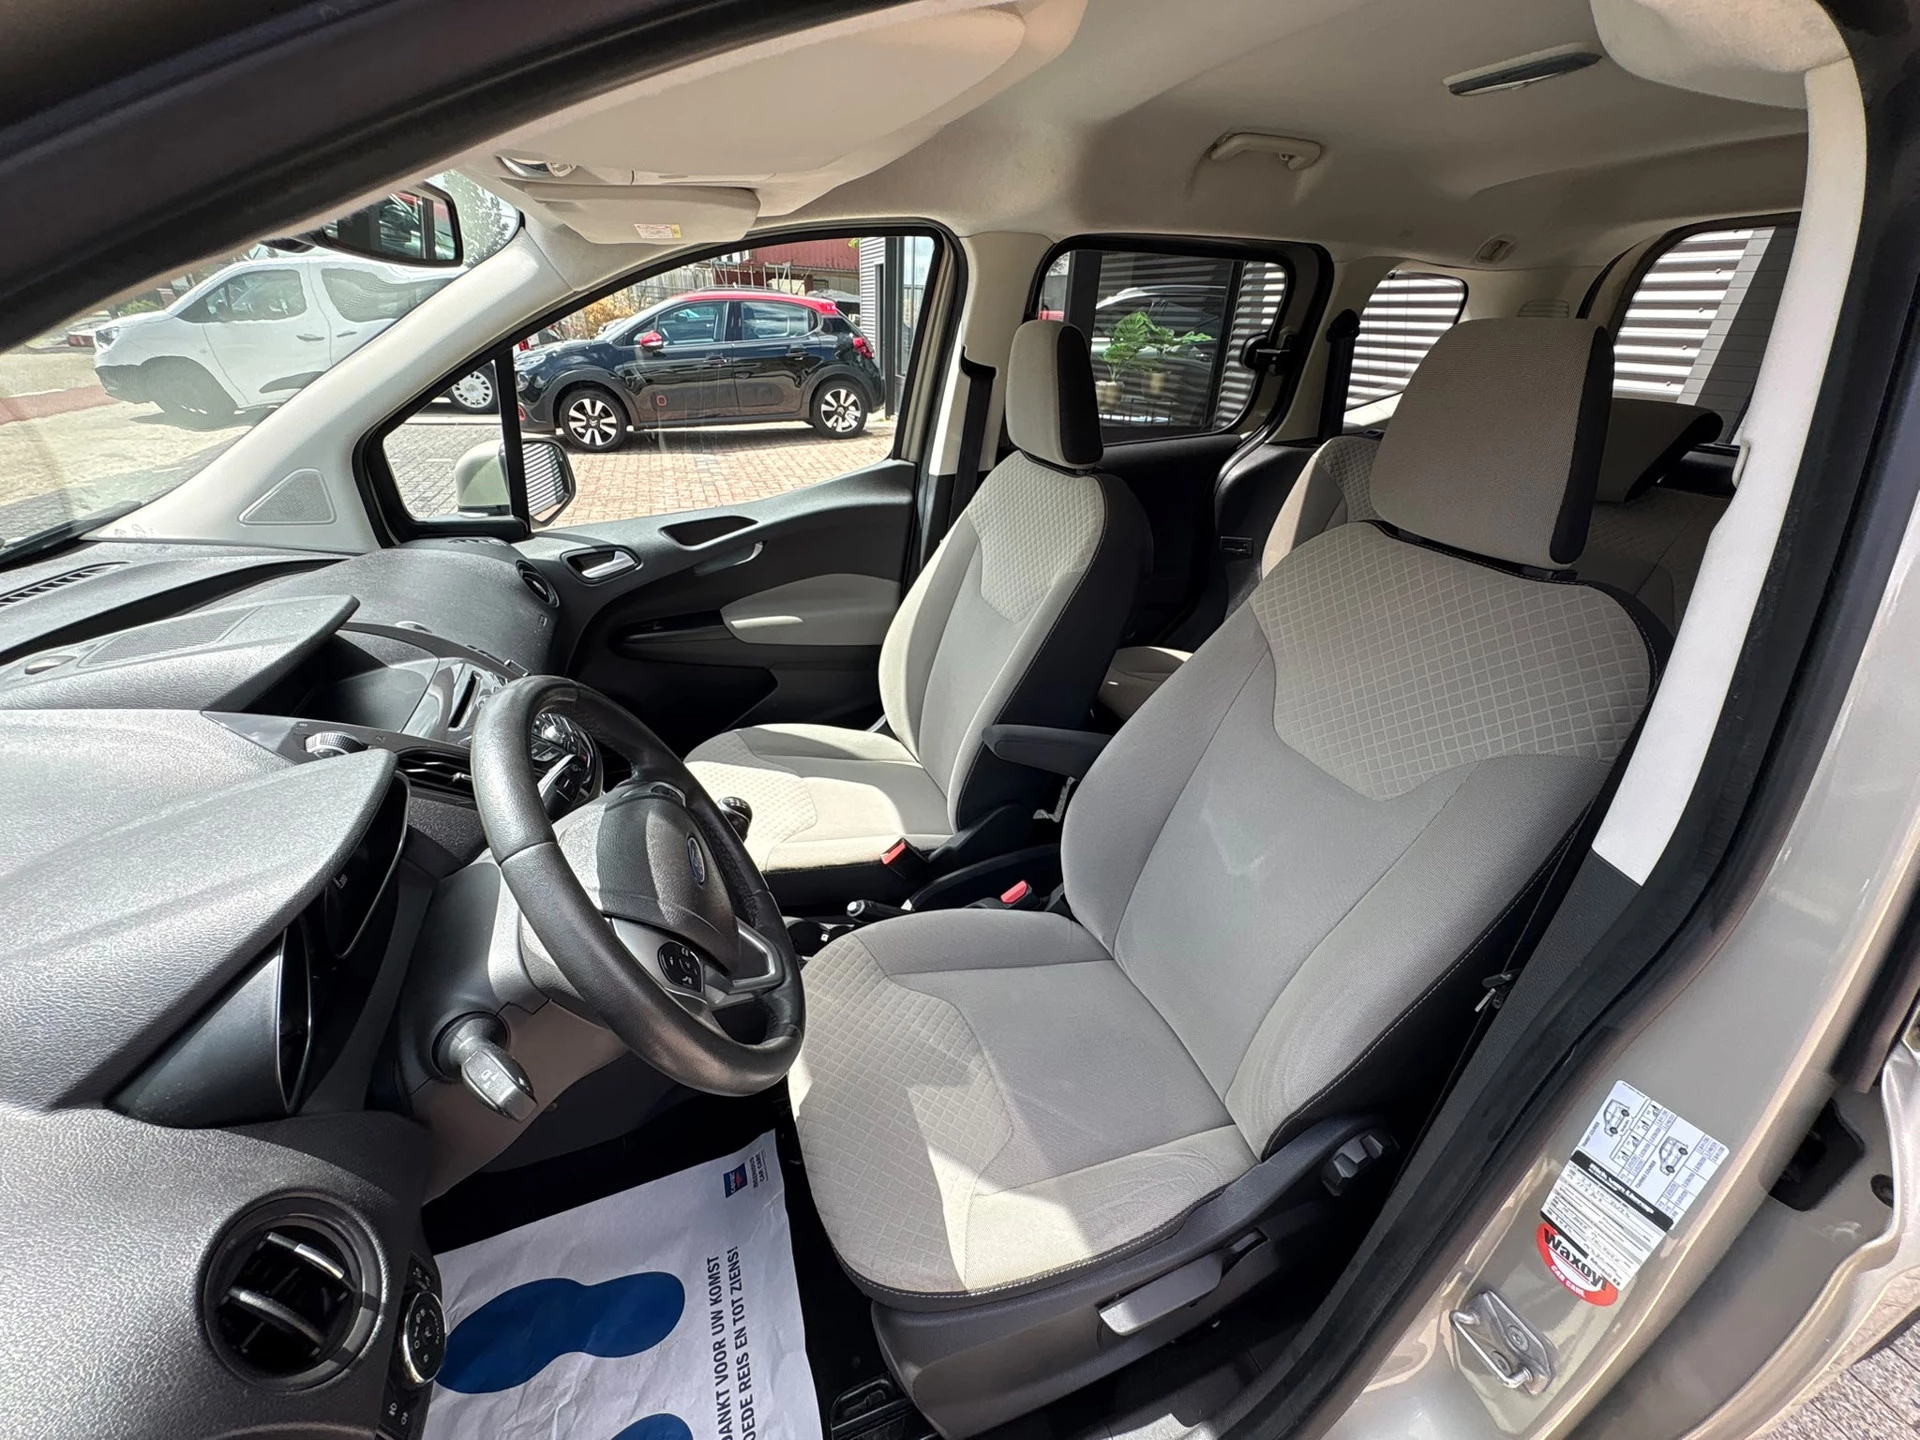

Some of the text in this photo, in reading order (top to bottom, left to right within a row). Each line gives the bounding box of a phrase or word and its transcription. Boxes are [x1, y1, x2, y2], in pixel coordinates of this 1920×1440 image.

[707, 1256, 722, 1306] KOMST
[727, 1246, 742, 1295] ZIENS!
[1550, 1265, 1566, 1281] CAR
[710, 1309, 725, 1336] UW
[731, 1297, 745, 1326] TOT
[734, 1326, 748, 1350] EN
[713, 1337, 729, 1387] VOOR
[736, 1352, 752, 1393] REIS
